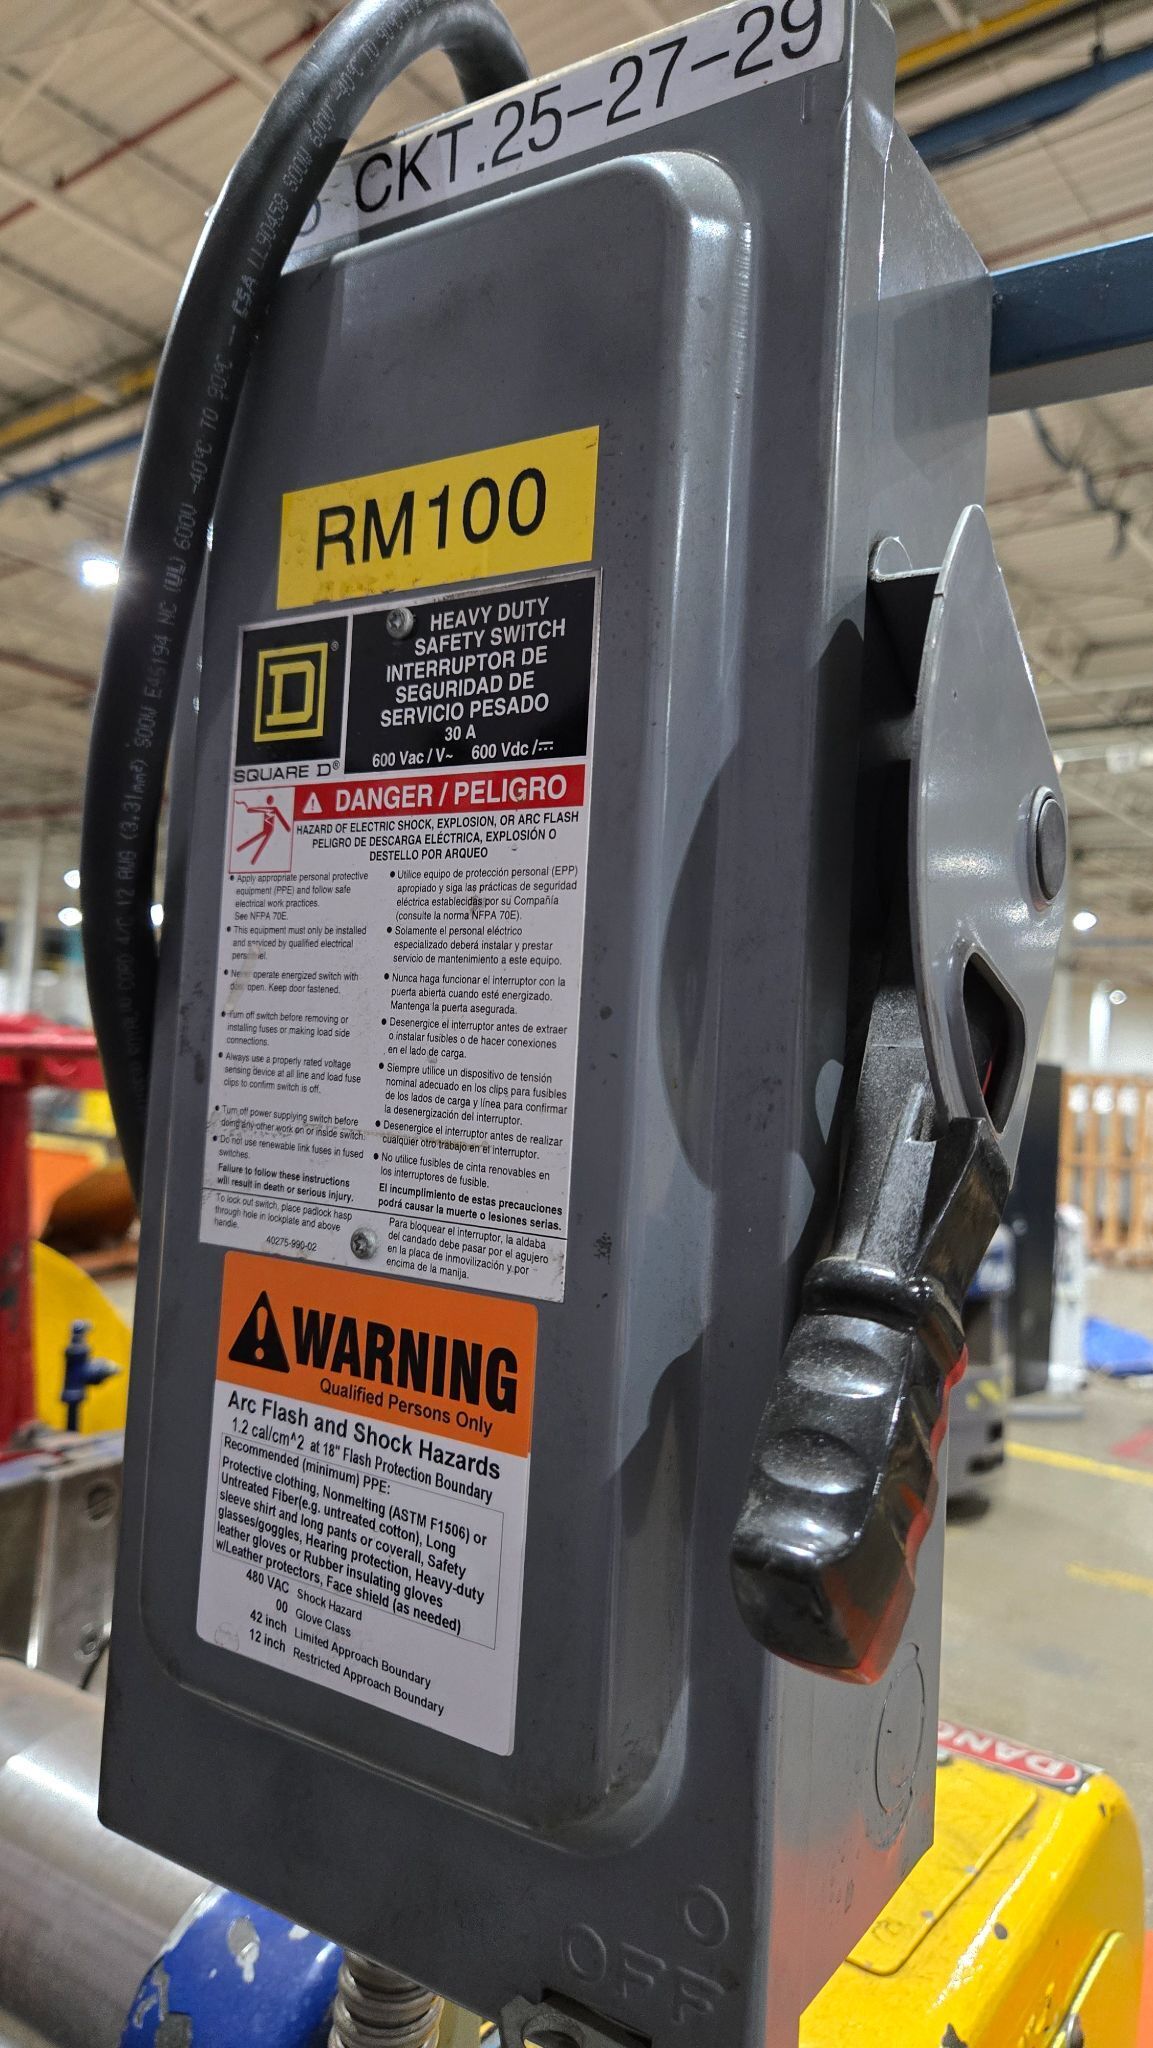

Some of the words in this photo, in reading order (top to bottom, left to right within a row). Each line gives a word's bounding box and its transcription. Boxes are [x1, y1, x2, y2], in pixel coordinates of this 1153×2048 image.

[315, 467, 547, 571] RM100
[413, 628, 485, 656] SAFETY
[489, 617, 566, 646] SWITCH
[429, 604, 493, 632] HEAVY
[497, 595, 550, 622] DUTY
[385, 648, 515, 683] INTERRUPTOR
[520, 644, 548, 666] DE
[394, 674, 503, 704] SEGURIDAD
[508, 669, 535, 691] DE
[379, 701, 464, 727] SERVICIO
[469, 692, 549, 718] PESADO
[443, 724, 462, 742] 30
[464, 723, 476, 739] A
[232, 763, 310, 783] SQUARE
[371, 751, 396, 768] 600
[398, 749, 424, 766] Vac
[470, 742, 497, 760] 600
[500, 740, 529, 757] Vdc
[334, 783, 433, 812] DANGER
[437, 781, 448, 807] /
[453, 773, 567, 805] PELIGRO
[296, 823, 333, 835] HAZARD
[334, 822, 348, 833] OF
[349, 819, 396, 833] ELECTRIC
[396, 817, 434, 831] SHOCK,
[436, 814, 497, 829] EXPLOSION,
[498, 813, 515, 826] OR
[516, 811, 541, 825] ARC
[542, 809, 579, 824] FLASH
[311, 836, 352, 849] PELIGRO
[353, 835, 367, 847] DE
[368, 833, 422, 847] DESCARGA
[423, 829, 483, 845] ELÉCTRICA,
[484, 825, 546, 842] EXPLOSIÓN
[547, 827, 557, 840] O
[368, 848, 419, 861] DESTELLO
[420, 847, 442, 860] POR
[443, 846, 488, 860] ARQUEO
[396, 868, 422, 879] Utilice
[422, 866, 451, 881] equipo
[451, 867, 464, 878] de
[464, 866, 509, 880] protección
[510, 865, 549, 879] personal
[550, 864, 578, 878] (EPP)
[217, 1161, 243, 1174] Failure
[243, 1165, 253, 1175] to
[253, 1166, 278, 1178] follow
[278, 1169, 301, 1182] these
[301, 1171, 350, 1188] instructions
[376, 1196, 403, 1209] podrá
[403, 1201, 434, 1213] causar
[435, 1203, 444, 1214] la
[445, 1206, 478, 1219] muerte
[478, 1211, 486, 1220] o
[487, 1210, 527, 1226] lesiones
[528, 1217, 562, 1231] serias.
[291, 1305, 518, 1414] WARNING
[319, 1376, 384, 1408] Qualified
[387, 1392, 451, 1424] Persons
[455, 1410, 493, 1438] Only
[226, 1389, 256, 1414] Arc
[261, 1397, 308, 1428] Flash
[313, 1415, 348, 1438] and
[352, 1421, 413, 1456] Shock
[418, 1437, 500, 1480] Hazards
[223, 1434, 300, 1468] Recommended
[301, 1456, 360, 1489] (minimum)
[362, 1474, 390, 1495] PPE:
[231, 1416, 249, 1435] 1.2
[309, 1439, 320, 1454] at
[342, 1446, 371, 1468] Flash
[373, 1454, 432, 1486] Protection
[434, 1471, 493, 1506] Boundary
[220, 1470, 269, 1497] Untreated
[271, 1486, 321, 1515] Fiber(e.g.
[323, 1504, 377, 1532] untreated
[378, 1522, 423, 1548] cotton),
[425, 1533, 456, 1559] Long
[221, 1454, 272, 1481] Protective
[274, 1472, 319, 1498] clothing,
[321, 1484, 386, 1519] Nonmelting
[387, 1504, 427, 1528] (ASTM
[429, 1516, 470, 1544] F1506)
[472, 1532, 487, 1546] or
[217, 1505, 302, 1545] glasses/goggles,
[304, 1531, 348, 1561] Hearing
[349, 1549, 412, 1582] protection,
[414, 1567, 485, 1605] Heavy-duty
[218, 1489, 251, 1509] sleeve
[252, 1499, 277, 1517] shirt
[277, 1508, 298, 1524] and
[299, 1512, 324, 1535] long
[325, 1523, 357, 1543] pants
[359, 1534, 373, 1548] or
[374, 1539, 424, 1567] coverall,
[426, 1553, 467, 1581] Safety
[215, 1538, 263, 1564] w/Leather
[264, 1555, 323, 1587] protectors,
[325, 1573, 353, 1595] Face
[354, 1586, 389, 1608] shield
[391, 1596, 410, 1615] (as
[412, 1606, 461, 1635] needed)
[216, 1519, 251, 1543] leather
[251, 1534, 287, 1555] gloves
[288, 1547, 301, 1560] or
[302, 1548, 344, 1574] Rubber
[345, 1562, 401, 1597] insulating
[403, 1584, 443, 1608] gloves
[245, 1567, 264, 1585] 480
[266, 1574, 290, 1594] VAC
[296, 1587, 326, 1609] Shock
[327, 1598, 363, 1621] Hazard
[274, 1597, 288, 1614] 00
[294, 1607, 323, 1627] Glove
[323, 1617, 351, 1638] Class
[248, 1627, 262, 1643] 12
[262, 1632, 286, 1653] inch
[292, 1645, 341, 1674] Restricted
[342, 1665, 391, 1694] Approach
[392, 1684, 444, 1717] Boundary
[249, 1608, 263, 1624] 42
[264, 1612, 287, 1633] inch
[293, 1626, 329, 1650] Limited
[330, 1640, 379, 1668] Approach
[380, 1658, 431, 1690] Boundary
[562, 1922, 726, 2026] OFF
